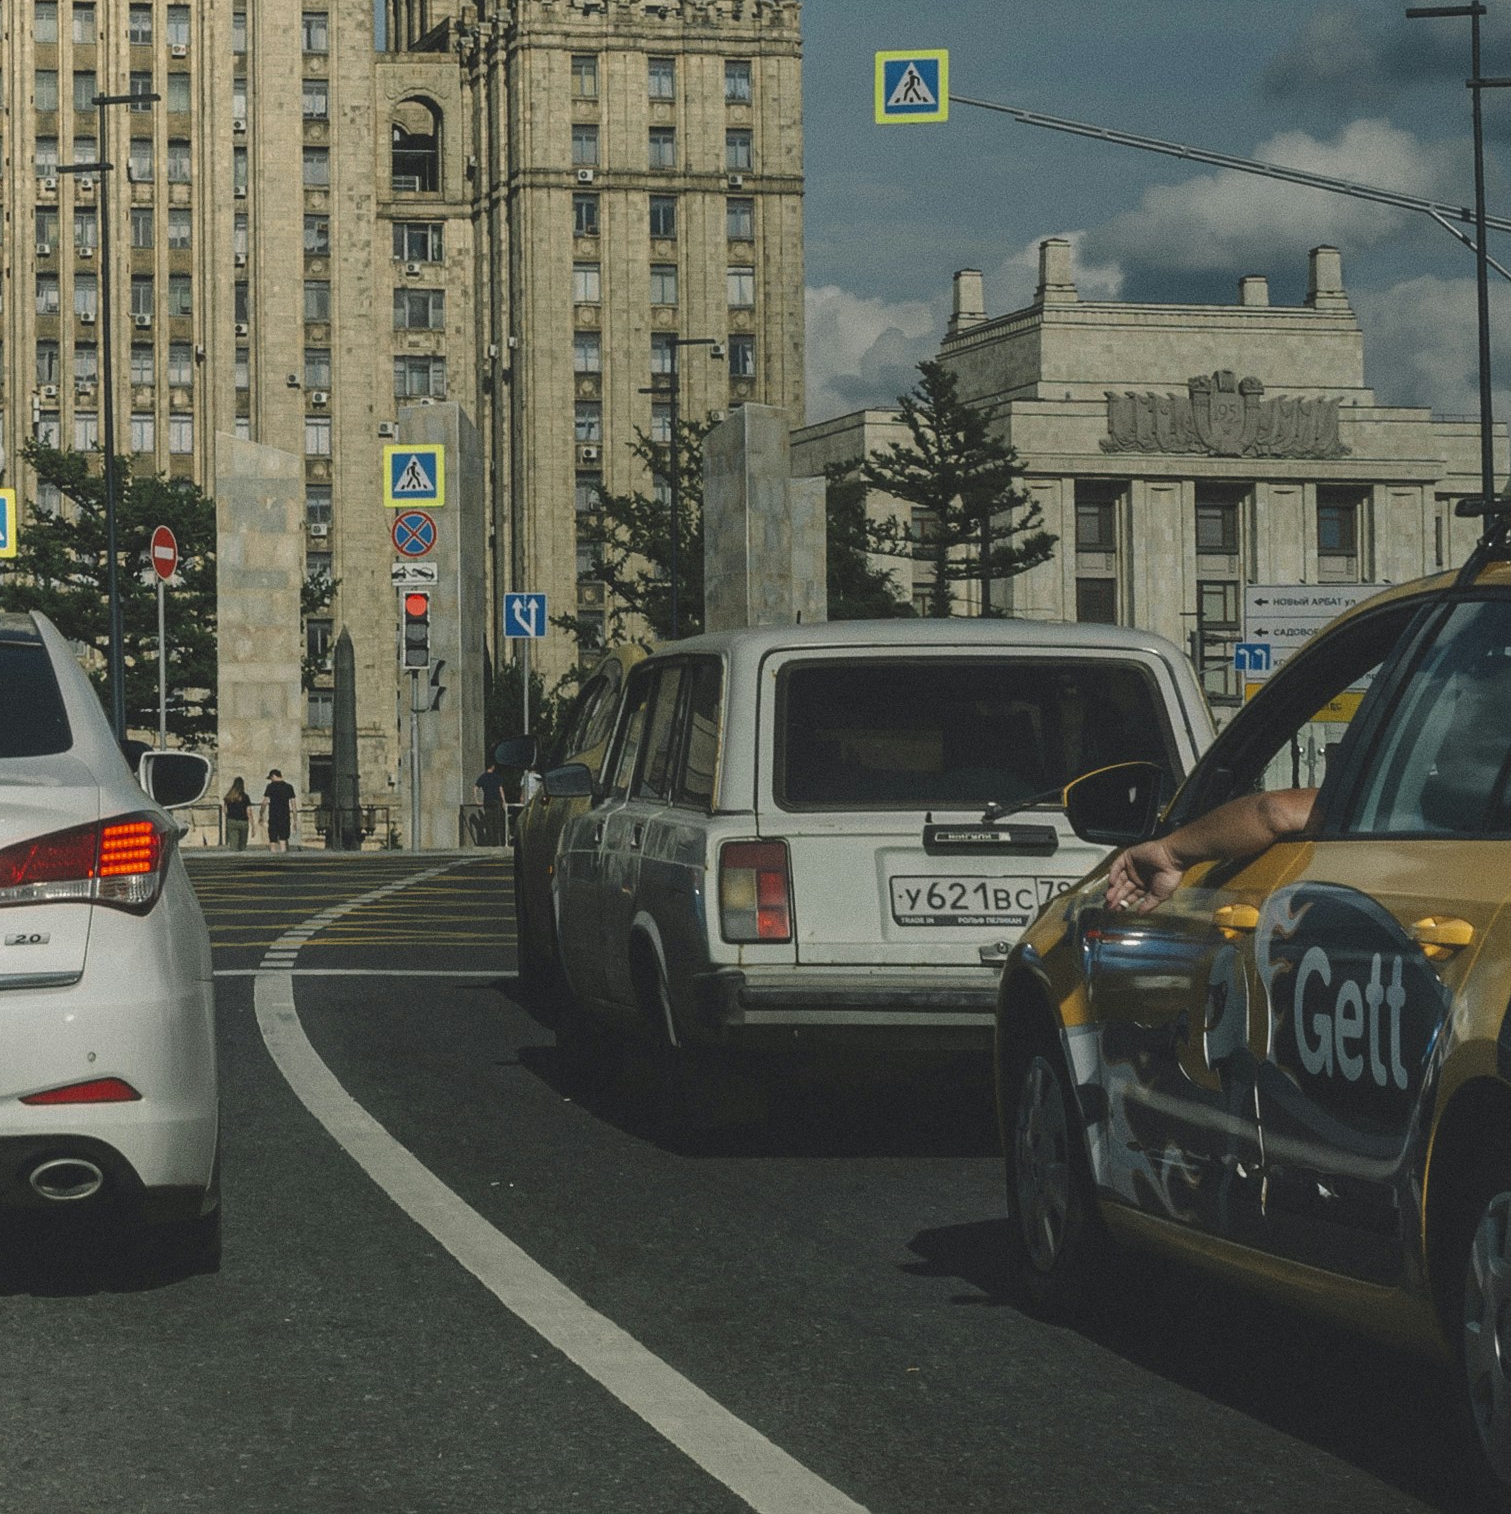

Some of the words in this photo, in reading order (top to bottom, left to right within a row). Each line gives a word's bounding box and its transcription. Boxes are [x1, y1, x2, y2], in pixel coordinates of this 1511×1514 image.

[1273, 597, 1309, 606] НОВЫЙ
[1311, 597, 1342, 606] АРБАТ
[1294, 946, 1409, 1090] Gett
